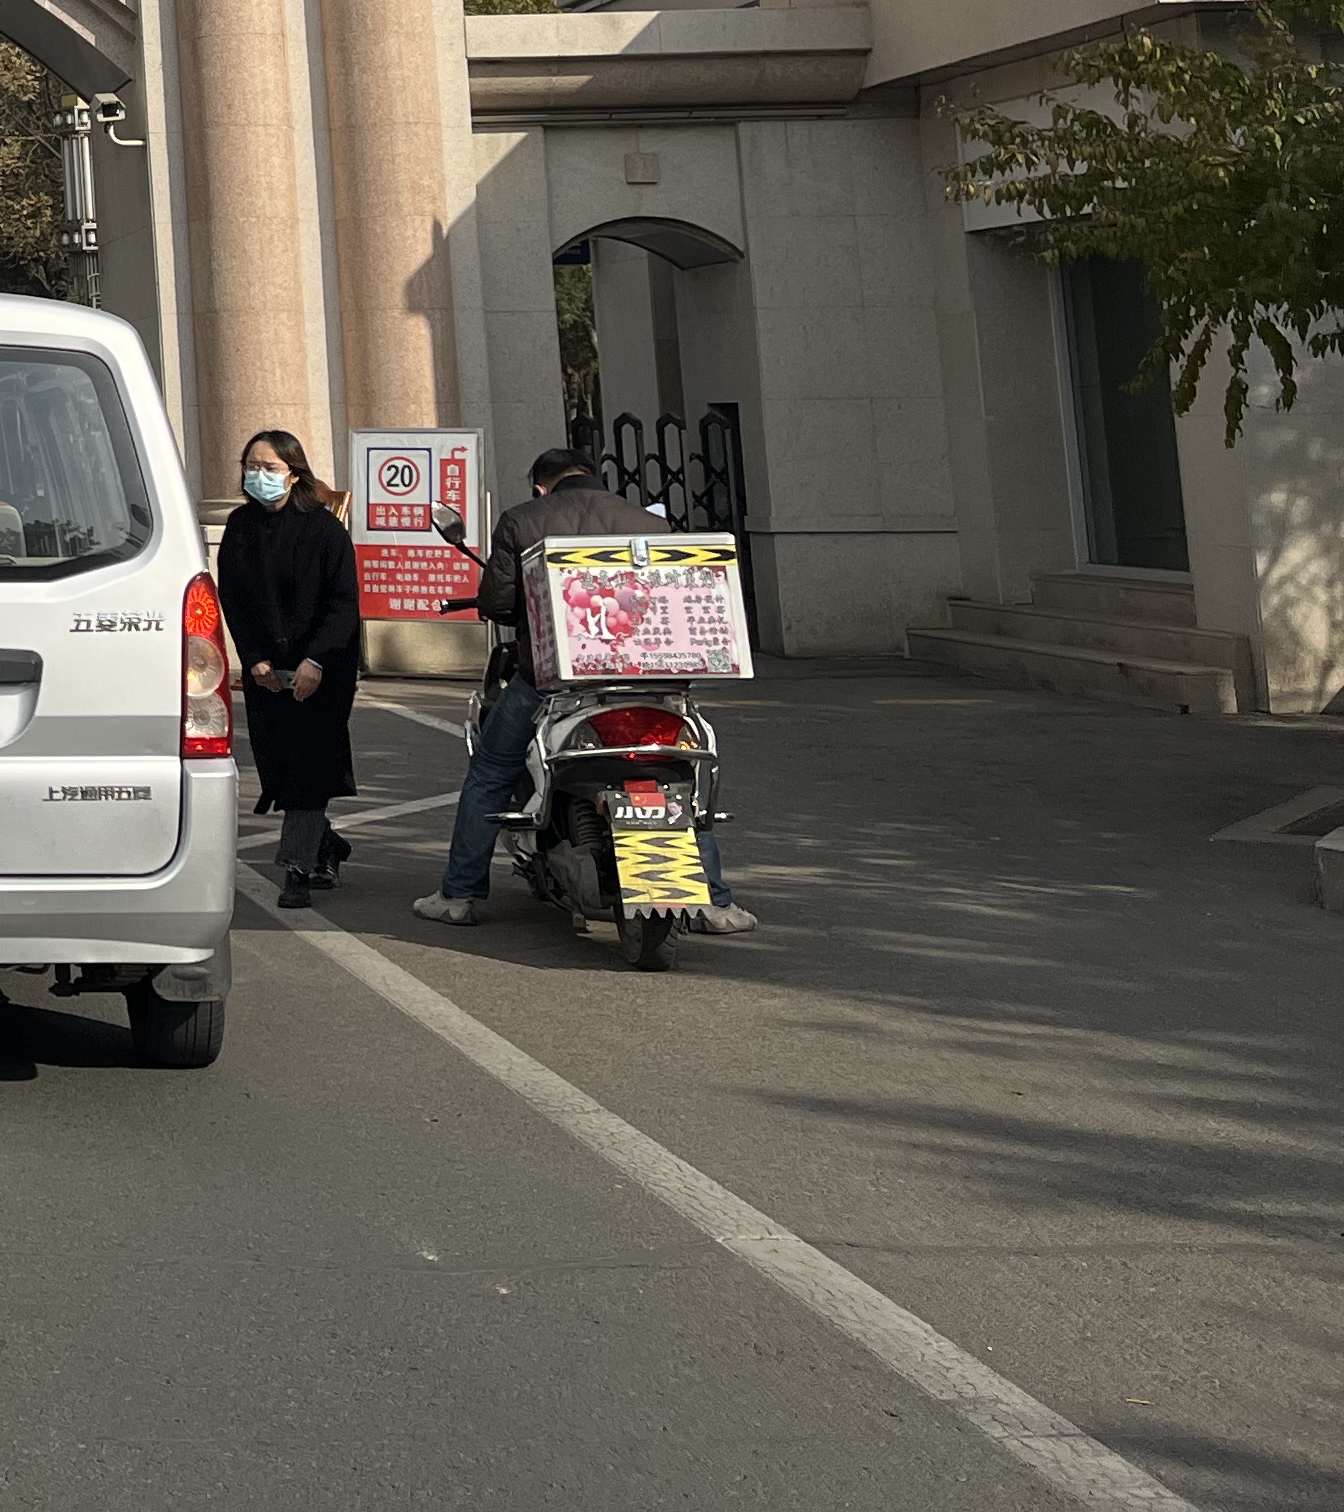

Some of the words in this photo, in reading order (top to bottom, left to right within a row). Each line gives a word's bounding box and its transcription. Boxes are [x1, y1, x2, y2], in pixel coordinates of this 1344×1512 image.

[386, 464, 414, 488] 20
[375, 505, 425, 516] 出入车辆
[69, 610, 165, 633] 五菱荣光
